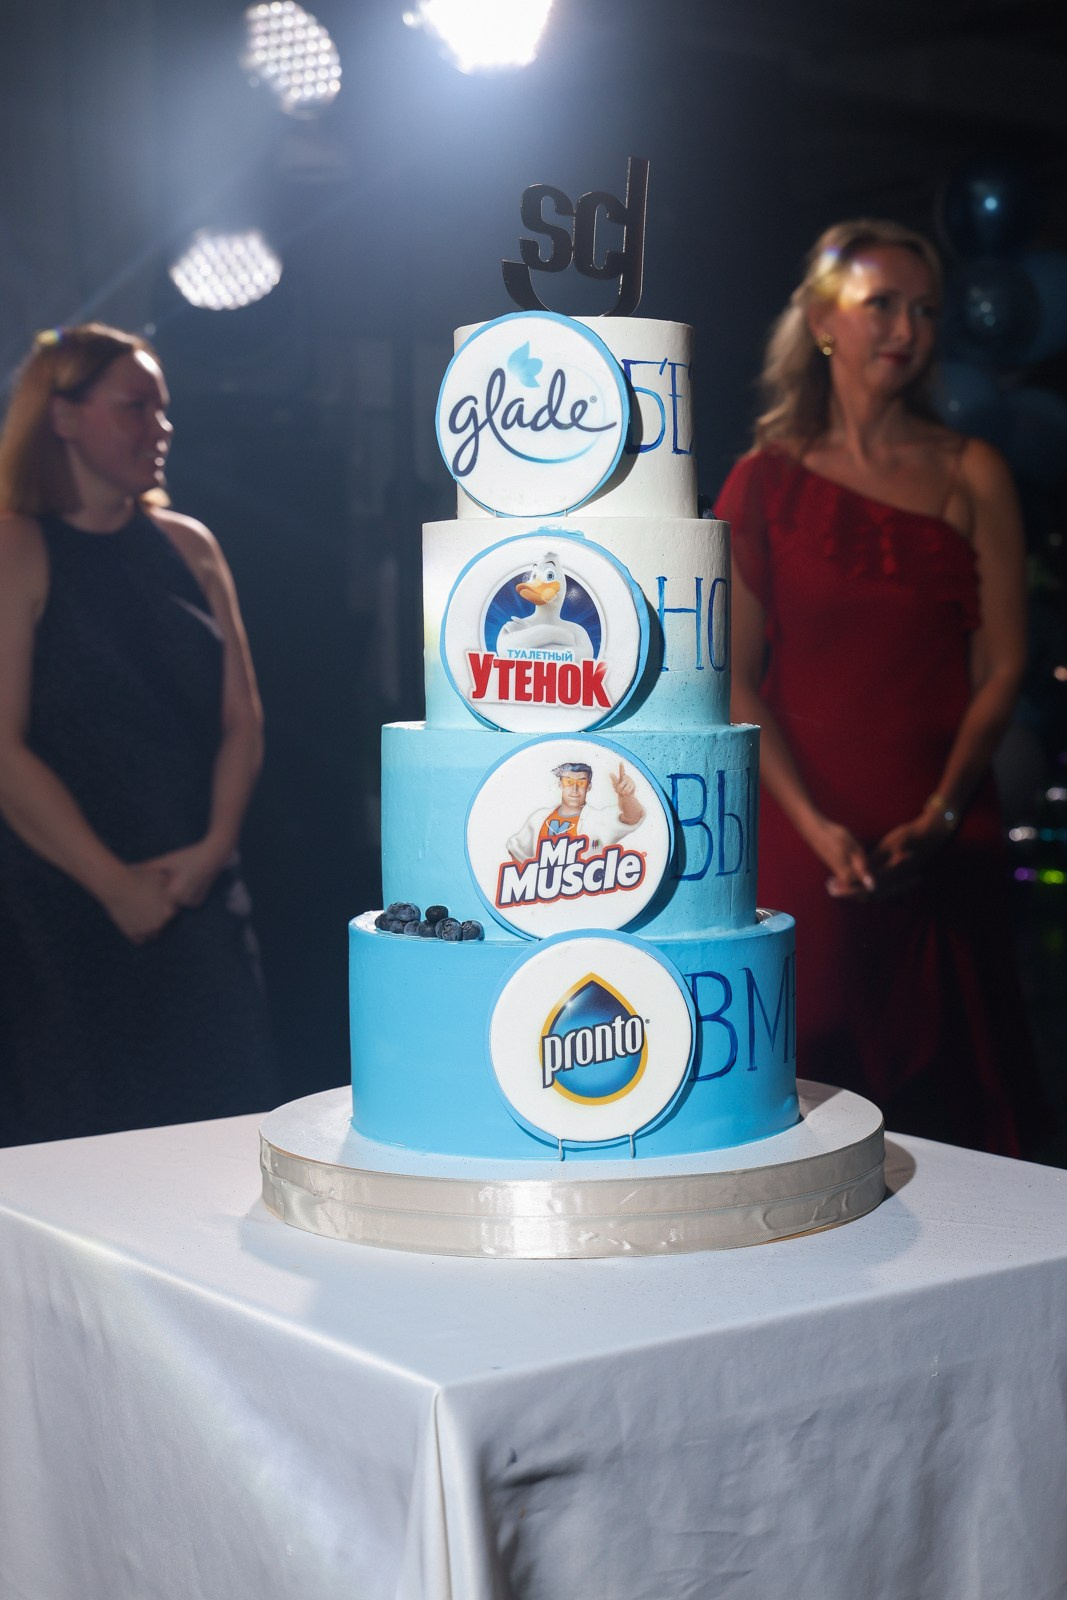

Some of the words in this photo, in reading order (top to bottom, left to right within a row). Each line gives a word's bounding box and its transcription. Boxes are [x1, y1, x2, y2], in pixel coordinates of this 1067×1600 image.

[449, 367, 617, 478] glade
[467, 652, 612, 708] УТЕНОК
[507, 649, 573, 662] ТУАЛЕТНЫЙ
[498, 848, 643, 906] Muscle
[539, 837, 587, 869] Mr
[542, 1014, 645, 1088] pronto
